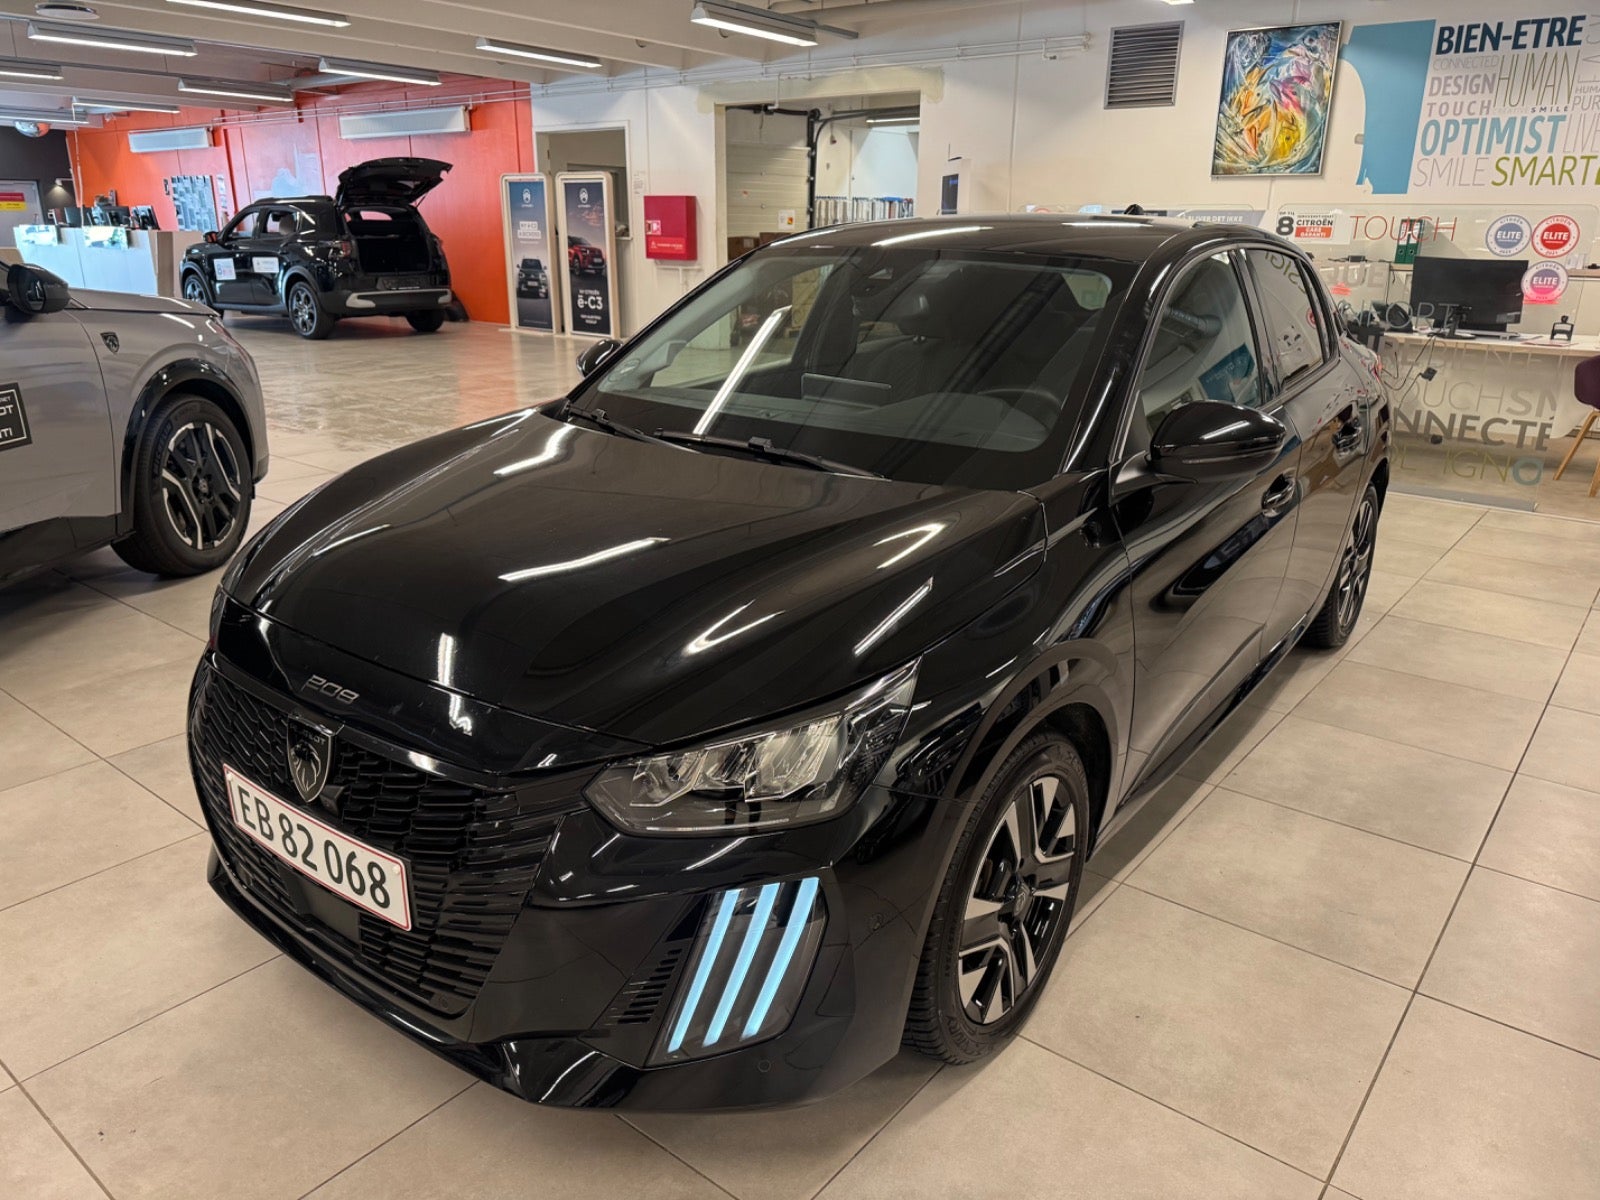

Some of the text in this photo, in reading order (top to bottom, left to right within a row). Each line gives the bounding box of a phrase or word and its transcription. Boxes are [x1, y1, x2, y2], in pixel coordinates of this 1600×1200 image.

[1435, 15, 1586, 55] BIEN-ETRE
[1432, 55, 1499, 71] CONNECTED
[1428, 73, 1497, 96] DESIGN
[1493, 50, 1580, 108] HUMAN
[1427, 100, 1491, 117] TOUCH
[1420, 115, 1567, 156] OPTIMIST
[1413, 157, 1490, 188] SMILE
[1491, 155, 1598, 187] SMART
[1276, 216, 1294, 236] 8
[1350, 215, 1457, 242] TOUCH
[1496, 230, 1522, 240] ELITE
[1542, 231, 1569, 241] ELITE
[1532, 276, 1559, 286] ELITE
[302, 674, 359, 701] 208
[237, 785, 391, 909] EB 82 068
